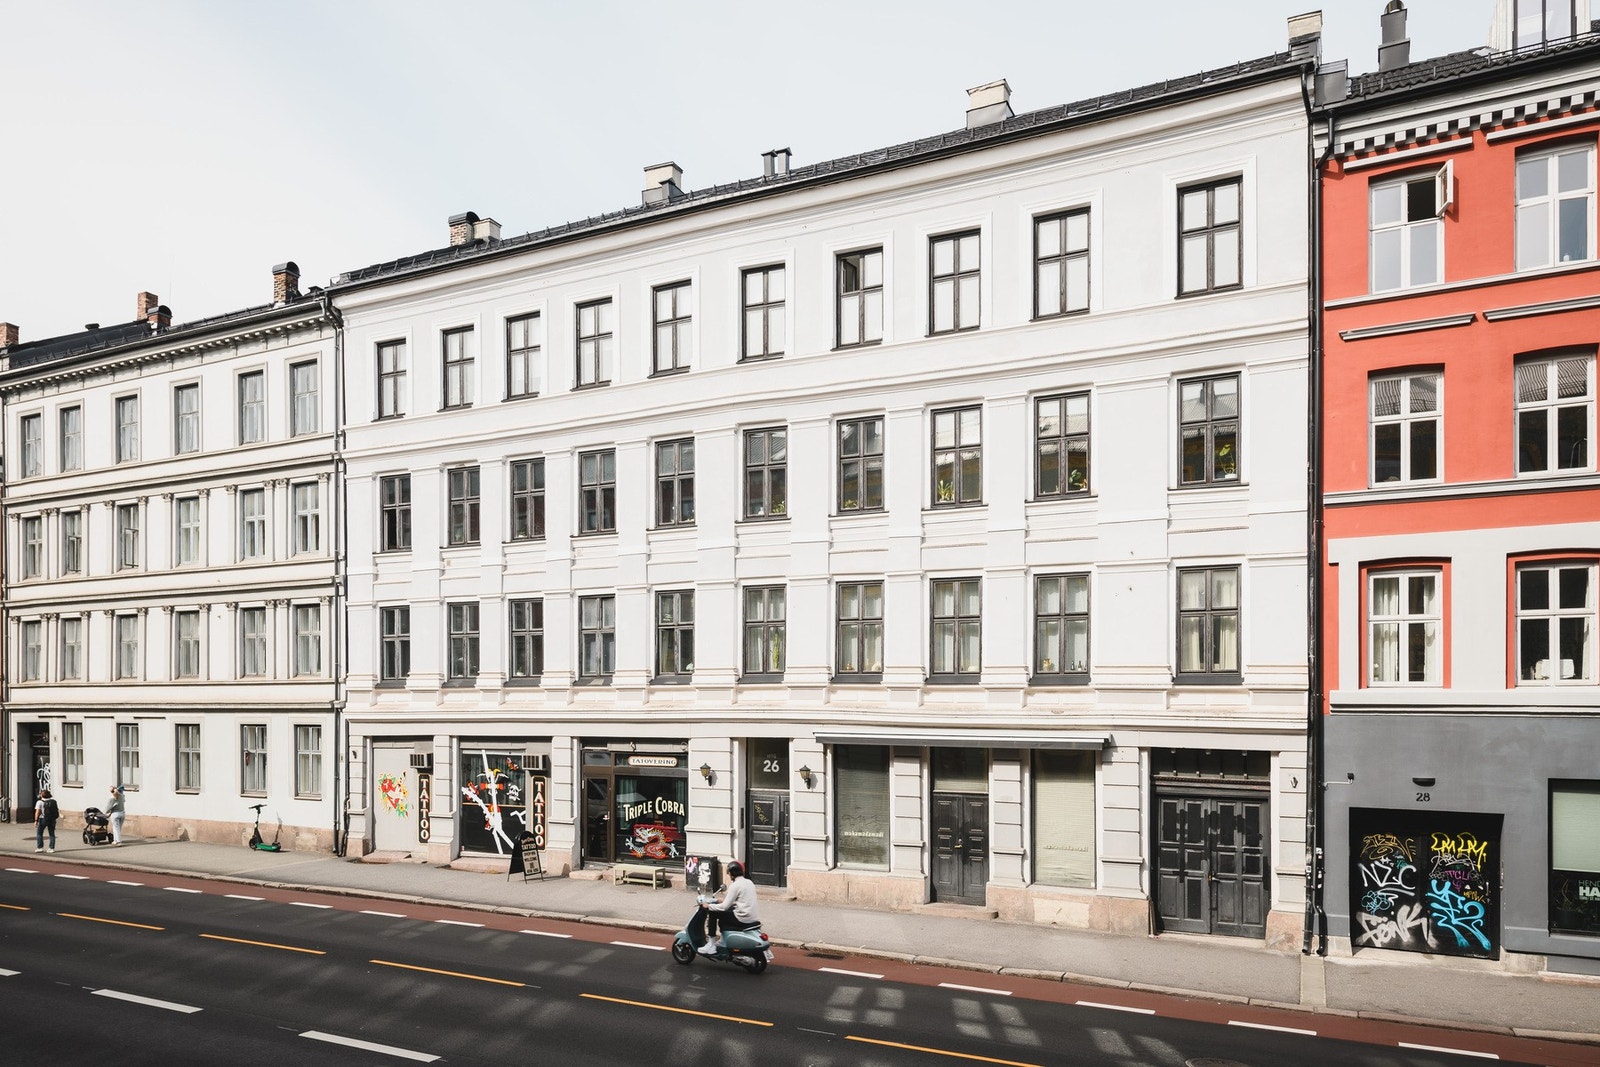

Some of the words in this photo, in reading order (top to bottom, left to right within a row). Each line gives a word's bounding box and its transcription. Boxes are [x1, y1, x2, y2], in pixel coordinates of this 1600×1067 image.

[763, 759, 780, 773] 26
[420, 778, 430, 839] TATTOO
[534, 781, 546, 847] TATTOO
[1415, 792, 1431, 803] 28
